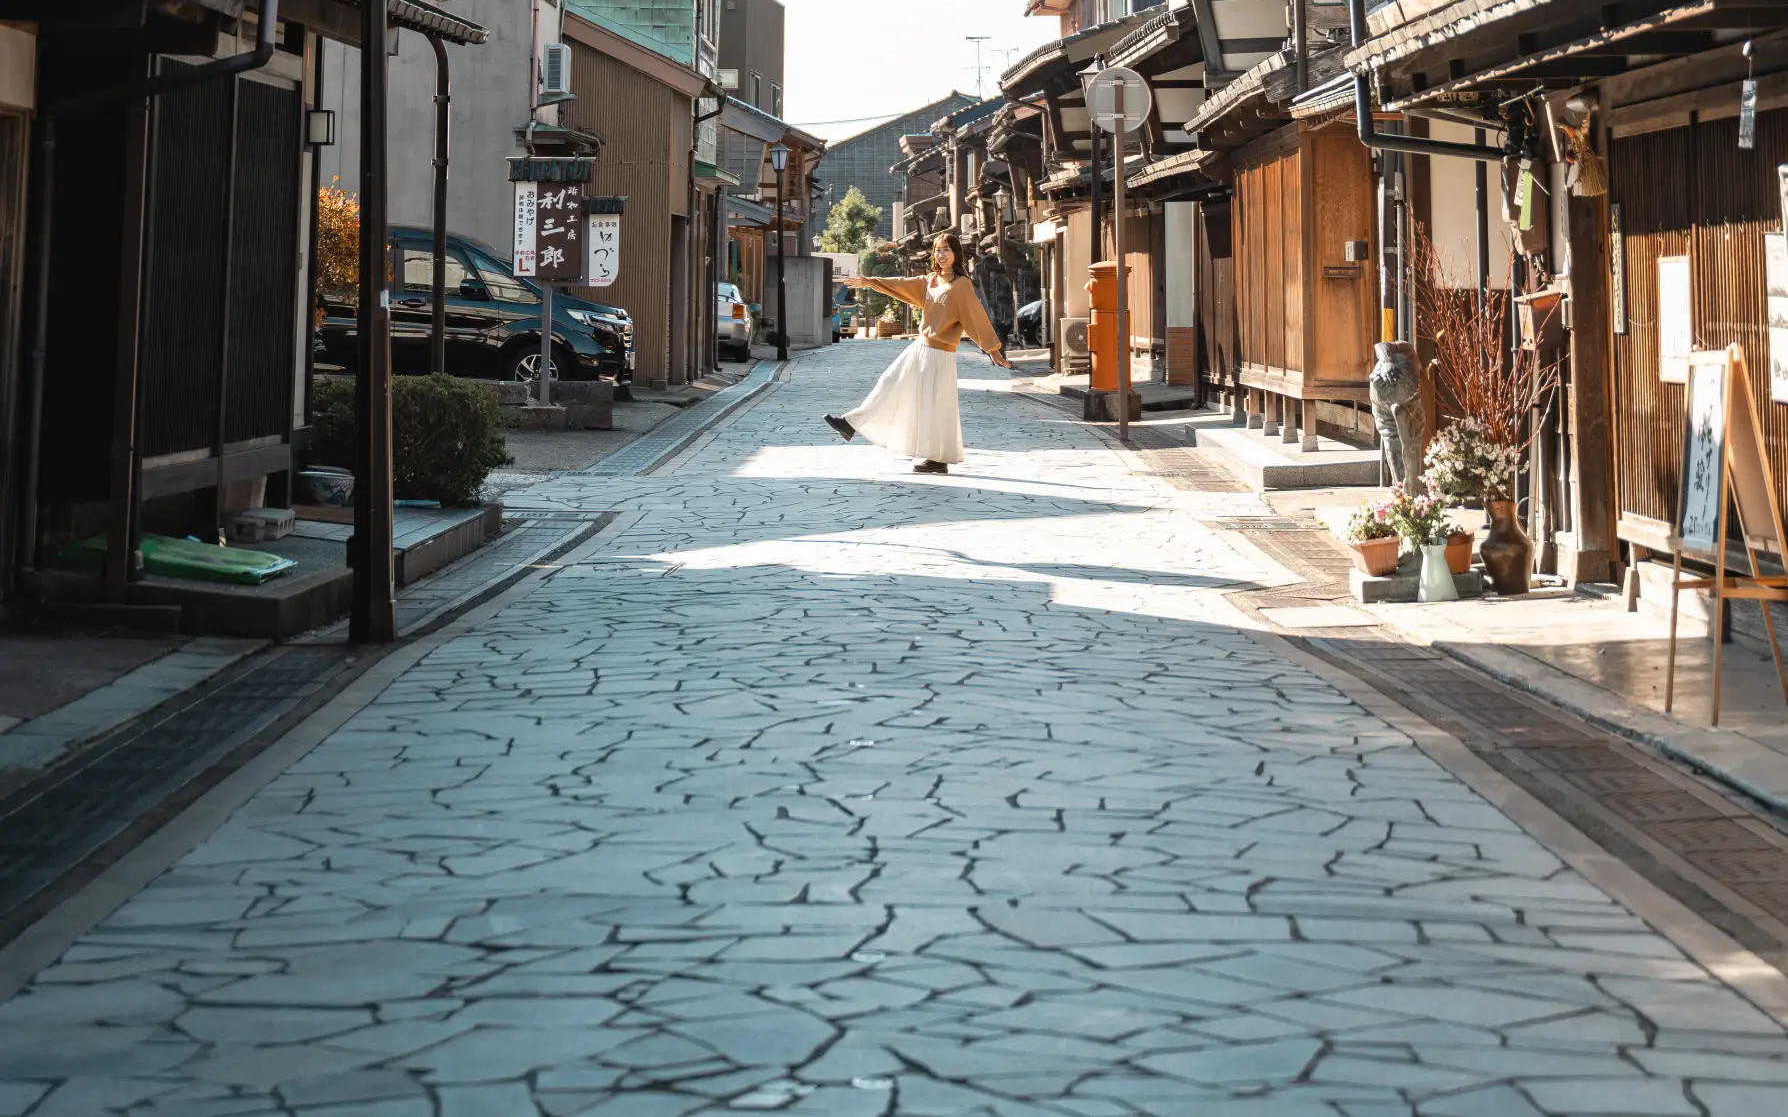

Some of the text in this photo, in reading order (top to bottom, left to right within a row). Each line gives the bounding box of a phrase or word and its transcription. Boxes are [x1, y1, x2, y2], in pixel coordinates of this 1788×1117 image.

[526, 190, 535, 226] おみやげ
[591, 221, 617, 229] お食事処
[537, 188, 566, 269] 利三郎
